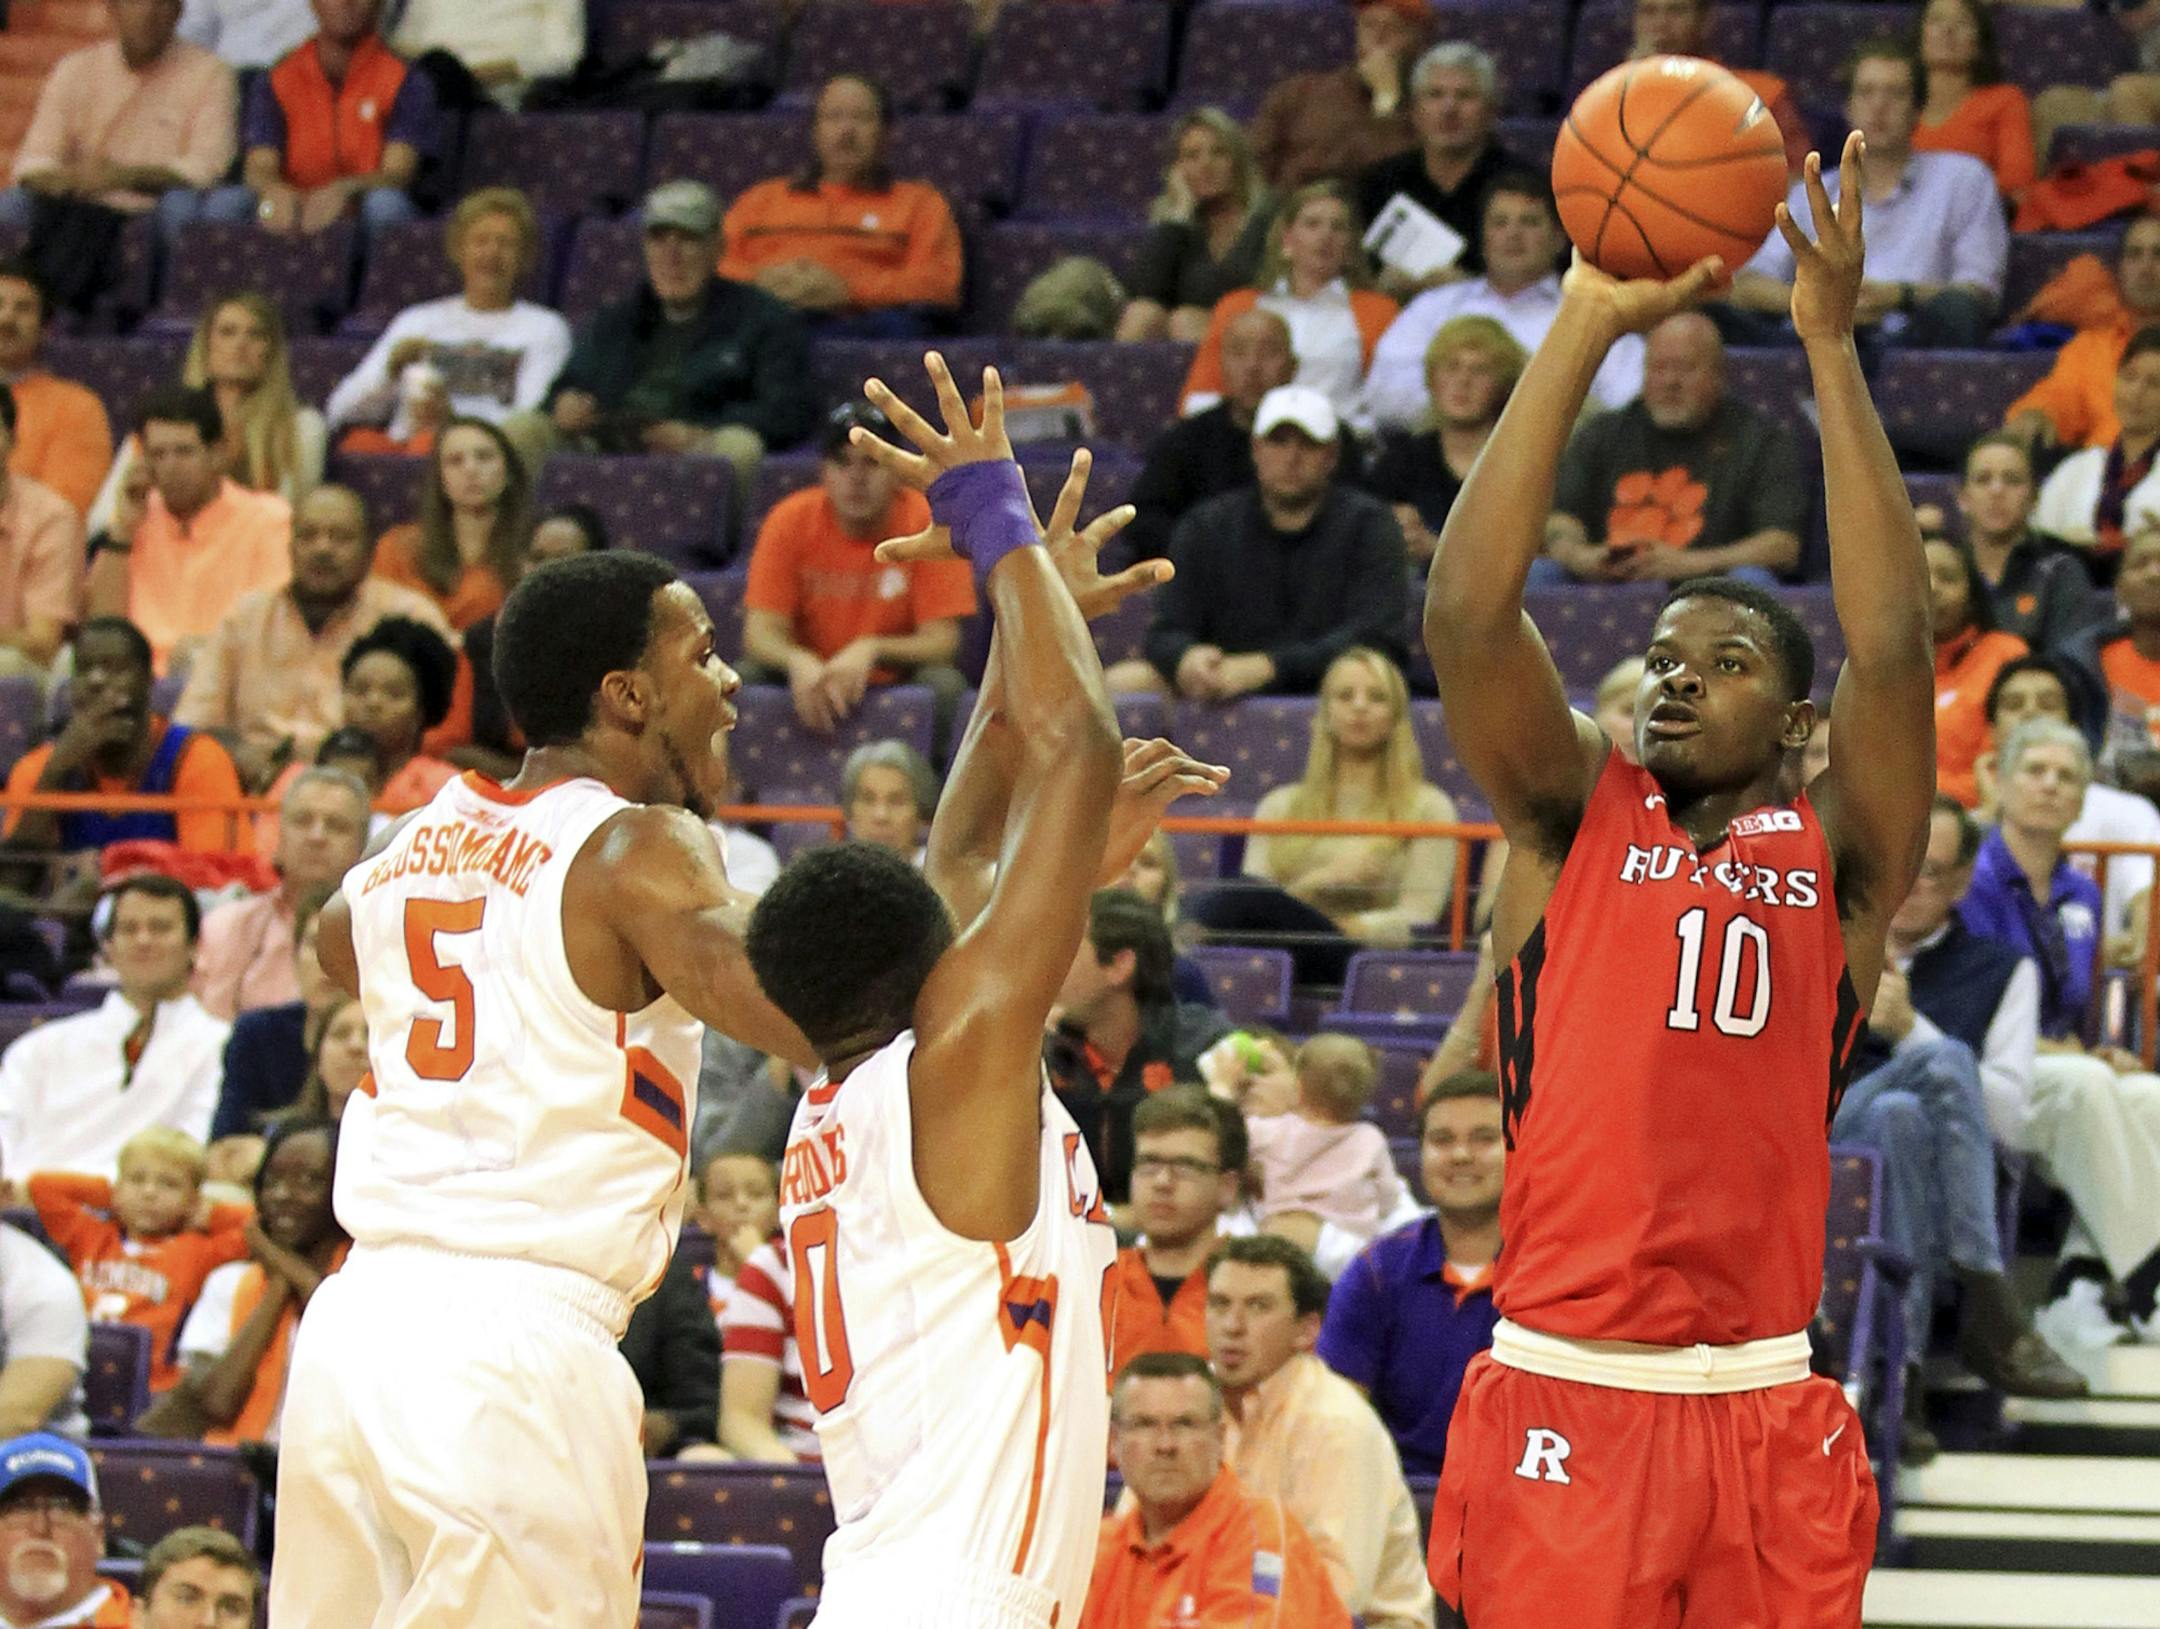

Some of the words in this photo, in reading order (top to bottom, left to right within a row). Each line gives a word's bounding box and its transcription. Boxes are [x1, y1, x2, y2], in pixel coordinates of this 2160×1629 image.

[403, 895, 488, 1082] 5
[1666, 905, 1773, 1039] 10
[790, 1206, 855, 1415] 0
[1513, 1426, 1572, 1486] R
